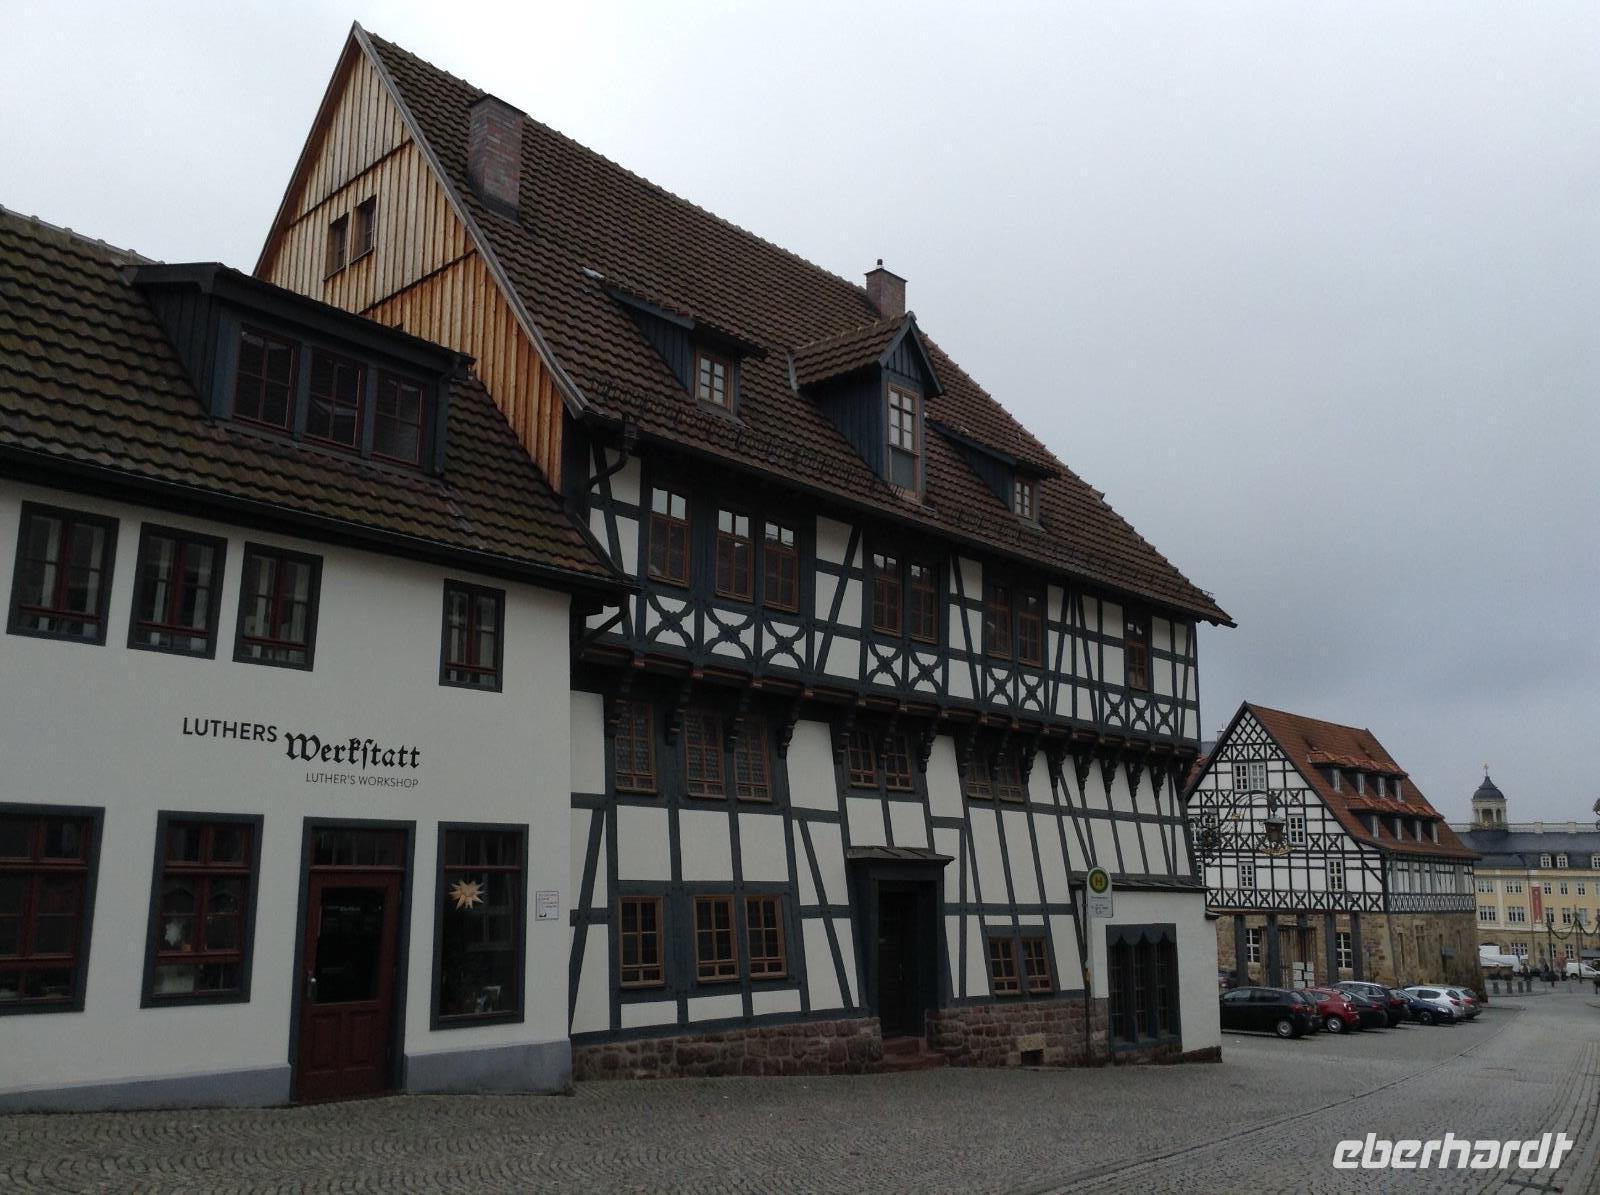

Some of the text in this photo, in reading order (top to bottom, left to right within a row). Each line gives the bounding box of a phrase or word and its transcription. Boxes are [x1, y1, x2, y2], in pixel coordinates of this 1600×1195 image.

[182, 717, 277, 742] LUTHERS
[305, 772, 419, 788] LUTHER'S WORKSHOP
